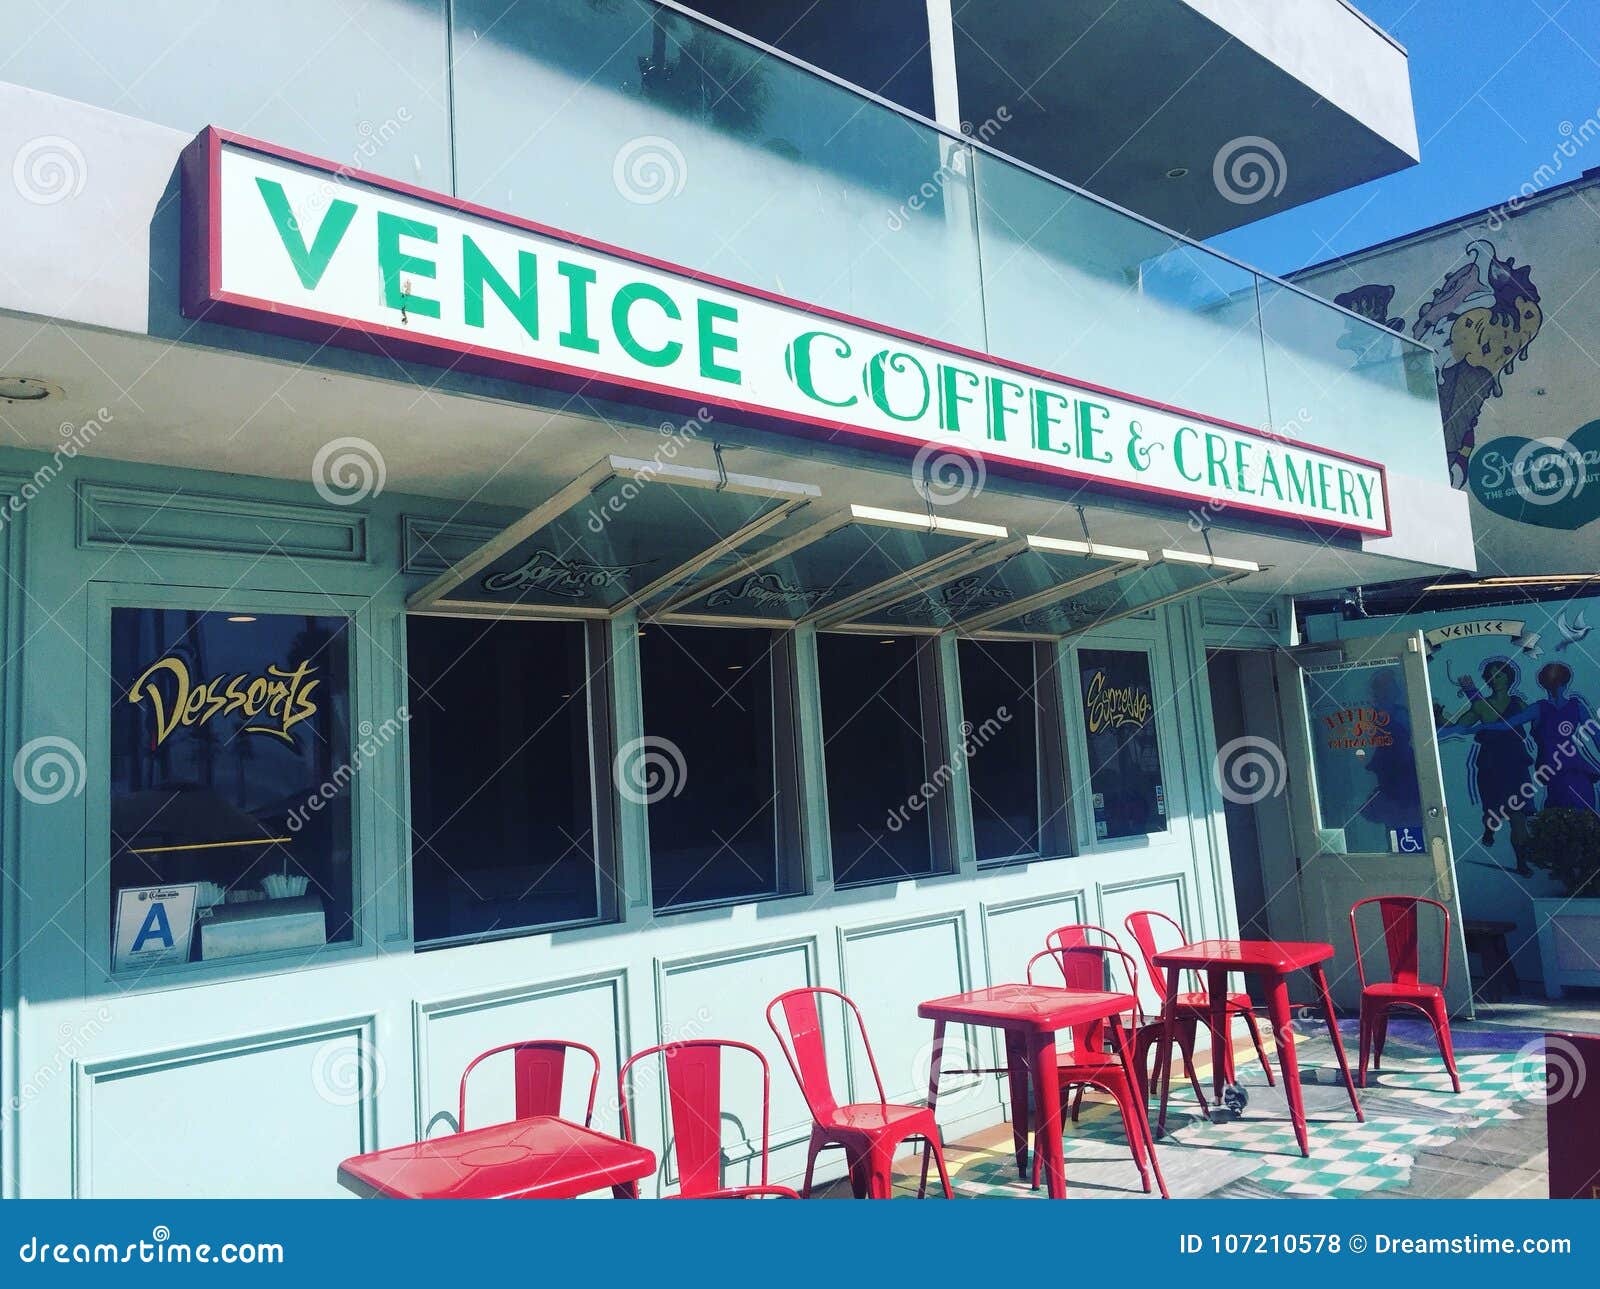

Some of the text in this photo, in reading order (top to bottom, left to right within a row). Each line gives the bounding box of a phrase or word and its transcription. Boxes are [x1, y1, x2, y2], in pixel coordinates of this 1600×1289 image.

[255, 177, 1377, 521] VENICE COFFEE & CREAMERY
[1440, 621, 1503, 639] VENICE
[128, 657, 321, 746] Desserts
[1087, 671, 1151, 733] Espresso
[130, 902, 175, 953] A
